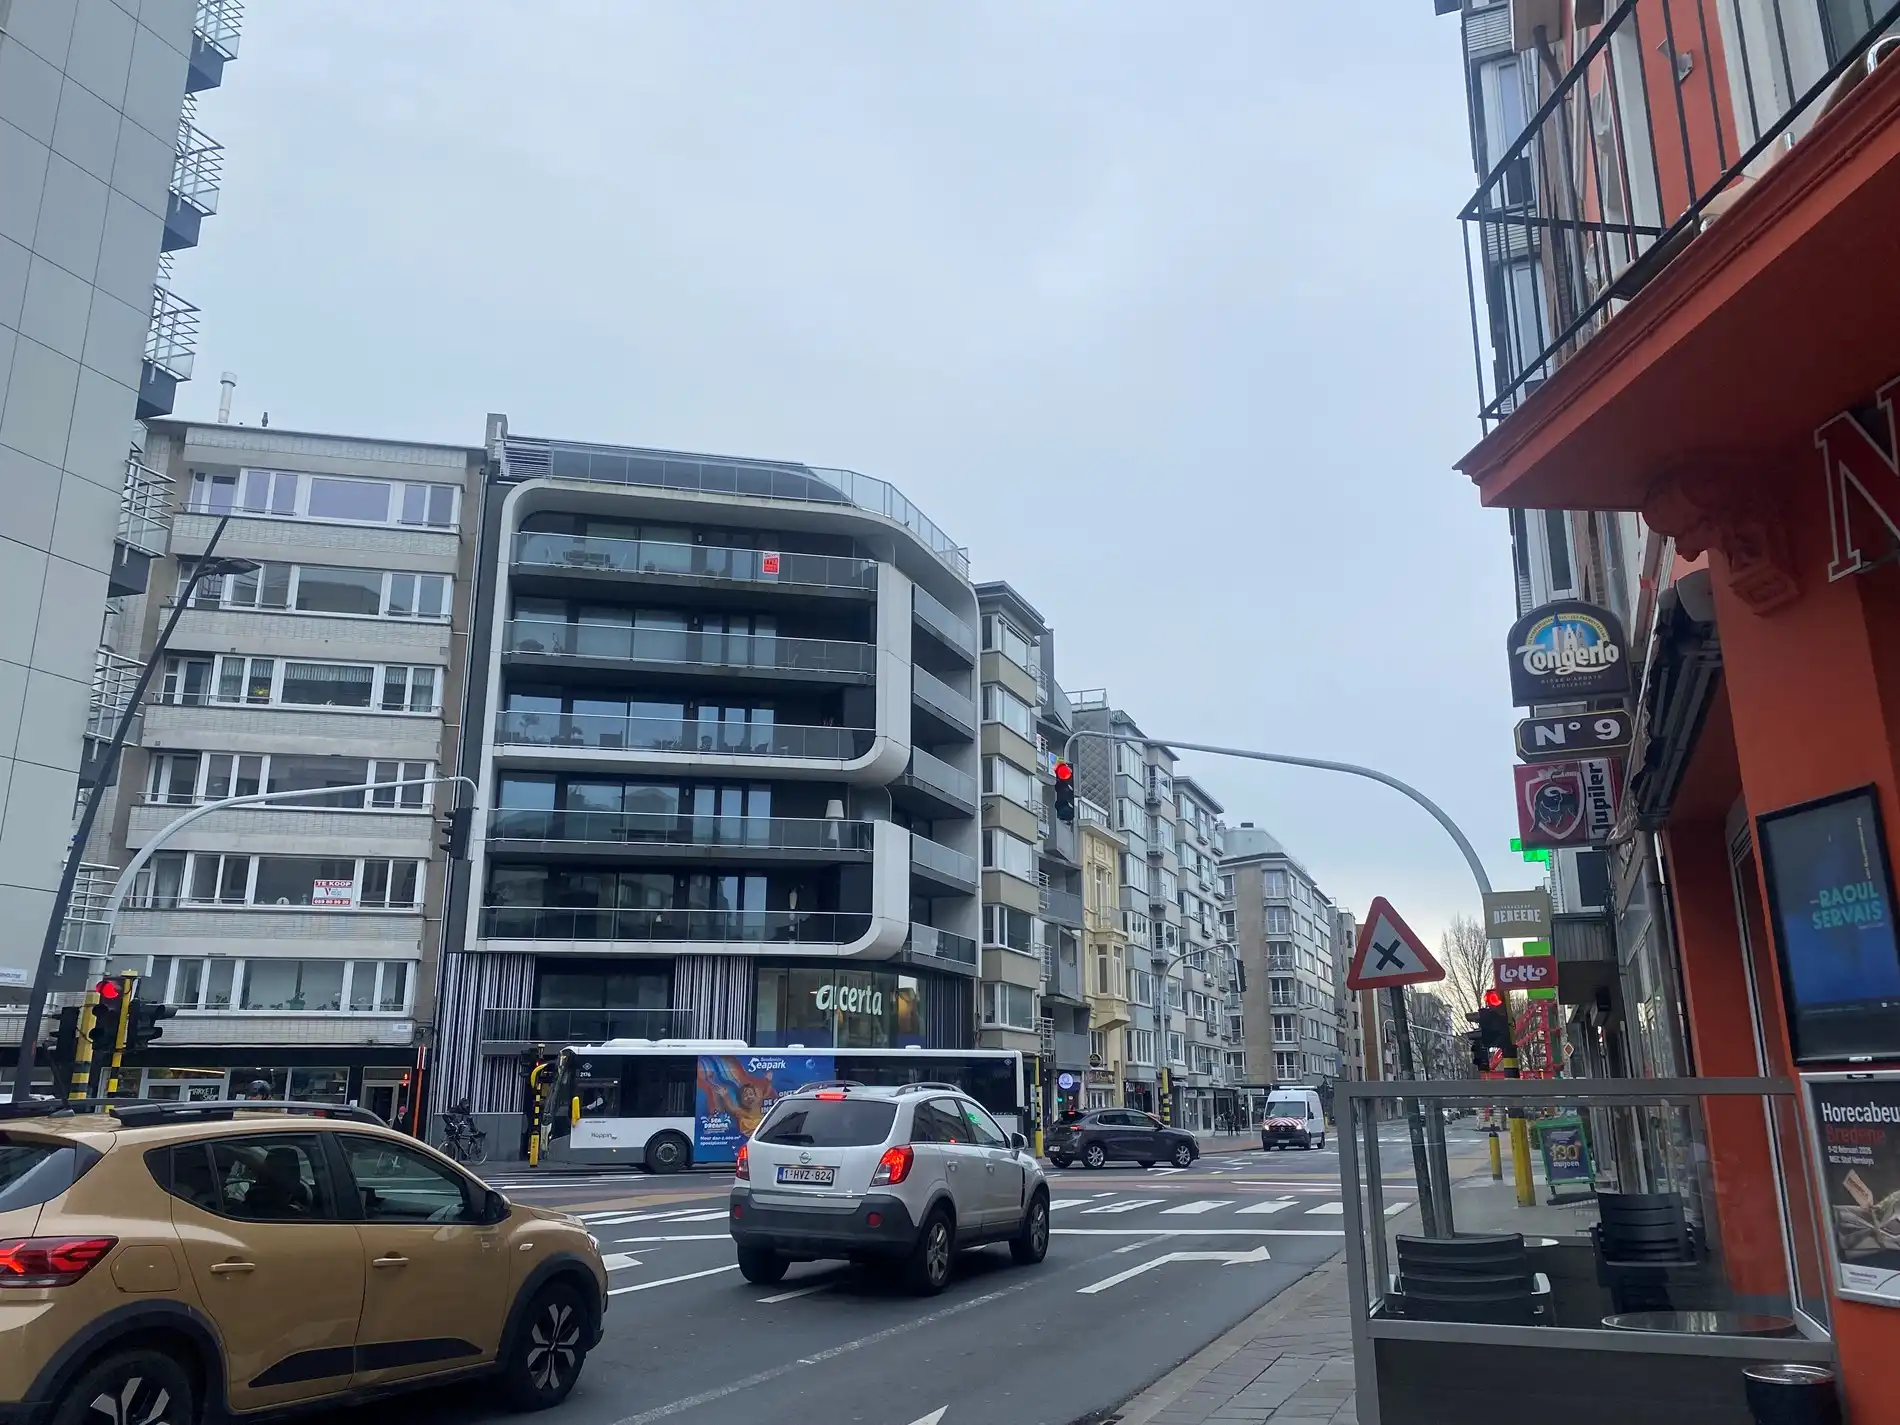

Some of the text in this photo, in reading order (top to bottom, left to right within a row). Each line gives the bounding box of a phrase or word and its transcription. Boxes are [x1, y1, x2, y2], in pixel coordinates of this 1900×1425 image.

[1515, 640, 1620, 675] Tongerlo
[1593, 718, 1621, 740] 9
[1588, 762, 1613, 835] Jupiler
[1819, 881, 1879, 908] RAOUL
[1812, 901, 1883, 930] SERVAIS
[815, 984, 882, 1016] acerta
[748, 1057, 786, 1073] Seapark
[188, 1087, 214, 1096] MARKET
[1821, 1101, 1900, 1123] Horecabeu
